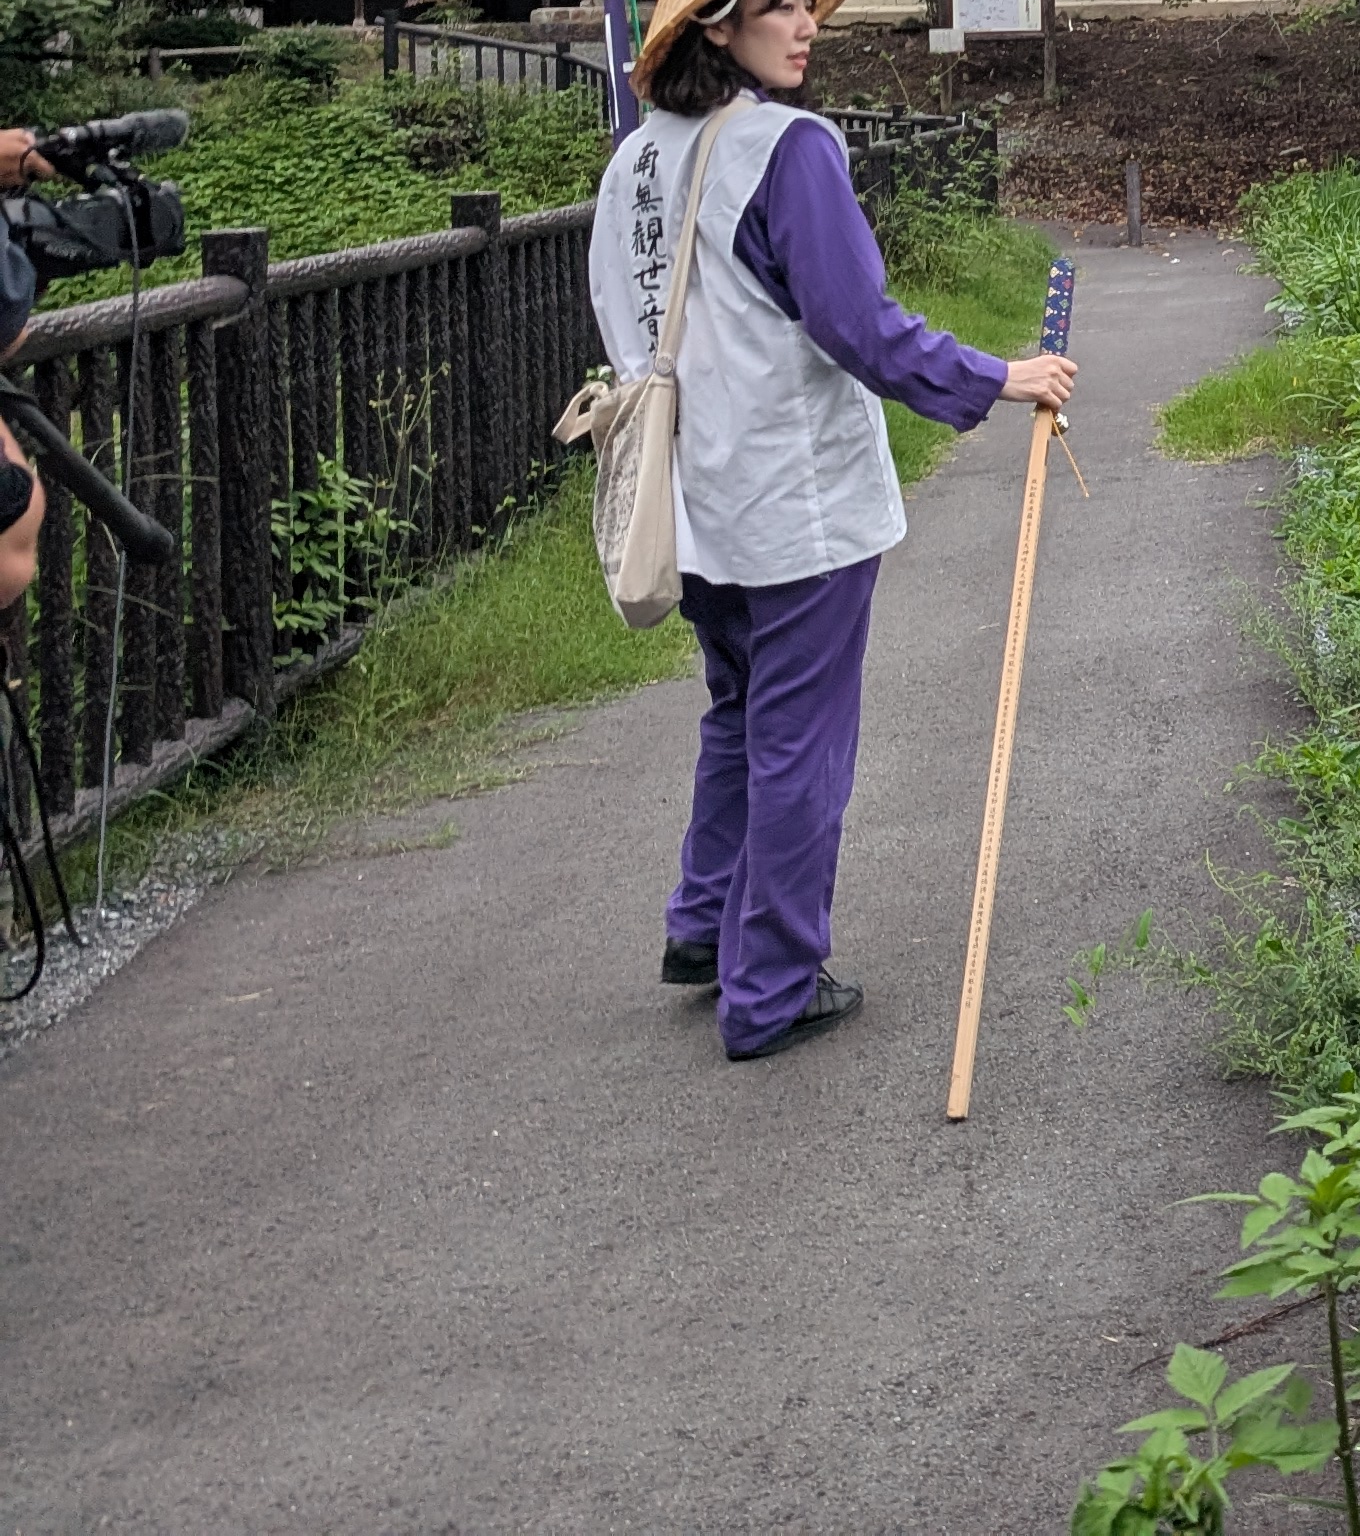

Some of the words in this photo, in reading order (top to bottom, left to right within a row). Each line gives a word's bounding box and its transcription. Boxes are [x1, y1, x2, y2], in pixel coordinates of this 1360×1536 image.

[631, 140, 668, 359] 南無観世音
